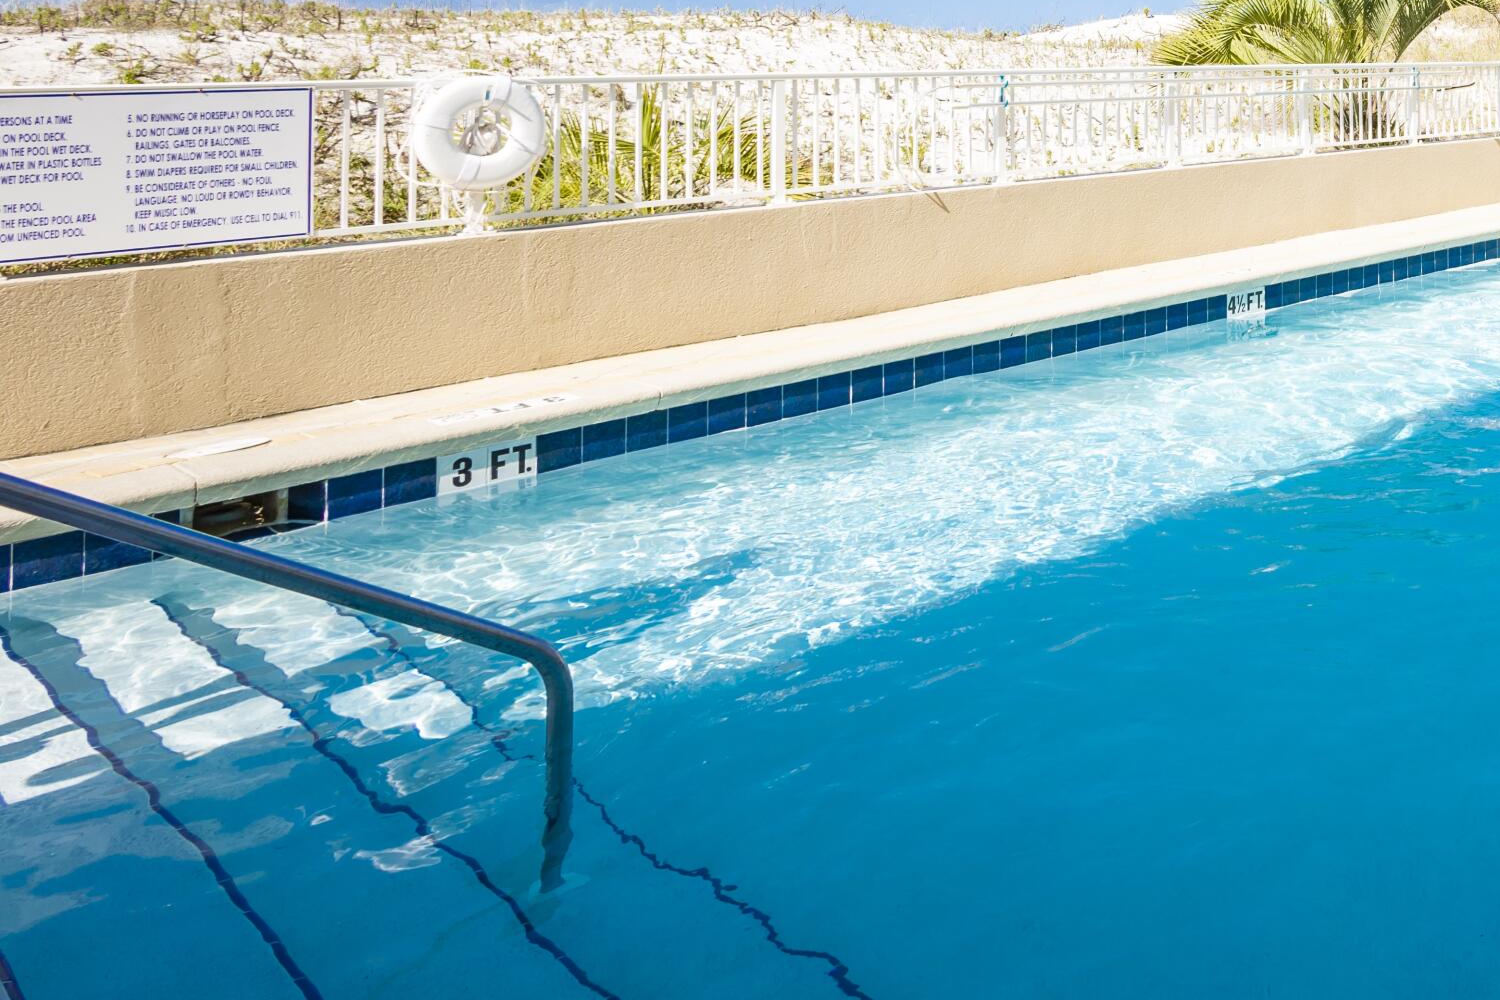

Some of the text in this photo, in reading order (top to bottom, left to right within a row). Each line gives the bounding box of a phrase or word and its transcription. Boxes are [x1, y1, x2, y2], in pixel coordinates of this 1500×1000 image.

[0, 115, 72, 126] ERSONS AT A TIME
[136, 113, 148, 122] NO
[150, 112, 185, 122] RUNNING
[188, 112, 198, 121] OR
[200, 111, 240, 120] HORSEPLAY
[242, 110, 253, 119] ON
[255, 110, 274, 118] POOL
[136, 128, 147, 137] DO
[150, 128, 165, 136] NOT
[168, 127, 189, 136] CLIMB
[192, 126, 202, 134] OR
[204, 126, 221, 134] PLAY
[224, 125, 235, 133] ON
[237, 124, 256, 133] POOL
[3, 134, 16, 143] ON
[19, 133, 41, 142] POOL
[174, 139, 196, 148] GATES
[198, 139, 208, 147] OR
[11, 148, 24, 156] THE
[27, 146, 49, 156] POOL
[52, 146, 67, 155] WET
[135, 155, 147, 163] DO
[150, 154, 165, 162] NOT
[167, 152, 202, 162] SWALLOW
[204, 151, 216, 159] THE
[218, 150, 238, 159] POOL
[28, 161, 35, 170] IN
[38, 158, 68, 169] PLASTIC
[72, 157, 102, 167] BOTTLES
[135, 169, 155, 178] SWIM
[157, 167, 186, 177] DIAPERS
[189, 165, 223, 175] REQUIRED
[225, 164, 238, 172] FOR
[241, 163, 262, 172] SMALL
[1, 172, 83, 184] WET DECK FOR POOL
[135, 184, 143, 193] BE
[145, 181, 196, 192] CONSIDERATE
[198, 180, 207, 189] OF
[210, 179, 235, 188] OTHERS
[242, 177, 253, 186] NO
[255, 176, 272, 185] FOUL
[181, 194, 193, 203] NO
[196, 192, 214, 202] LOUD
[216, 191, 226, 200] OR
[229, 190, 254, 199] ROWDY
[3, 204, 17, 213] THE
[135, 210, 151, 219] KEEP
[154, 208, 177, 217] MUSIC
[1, 213, 96, 228] THE FENCED POOL AREA
[139, 223, 146, 232] IN
[149, 222, 168, 231] CASE
[171, 221, 180, 229] OF
[231, 216, 243, 224] USE
[245, 215, 260, 223] CELL
[262, 213, 270, 221] TO
[273, 212, 288, 221] DIAL
[0, 233, 14, 243] OM
[17, 229, 60, 241] UNFENCED
[452, 443, 532, 487] 3 FT.
